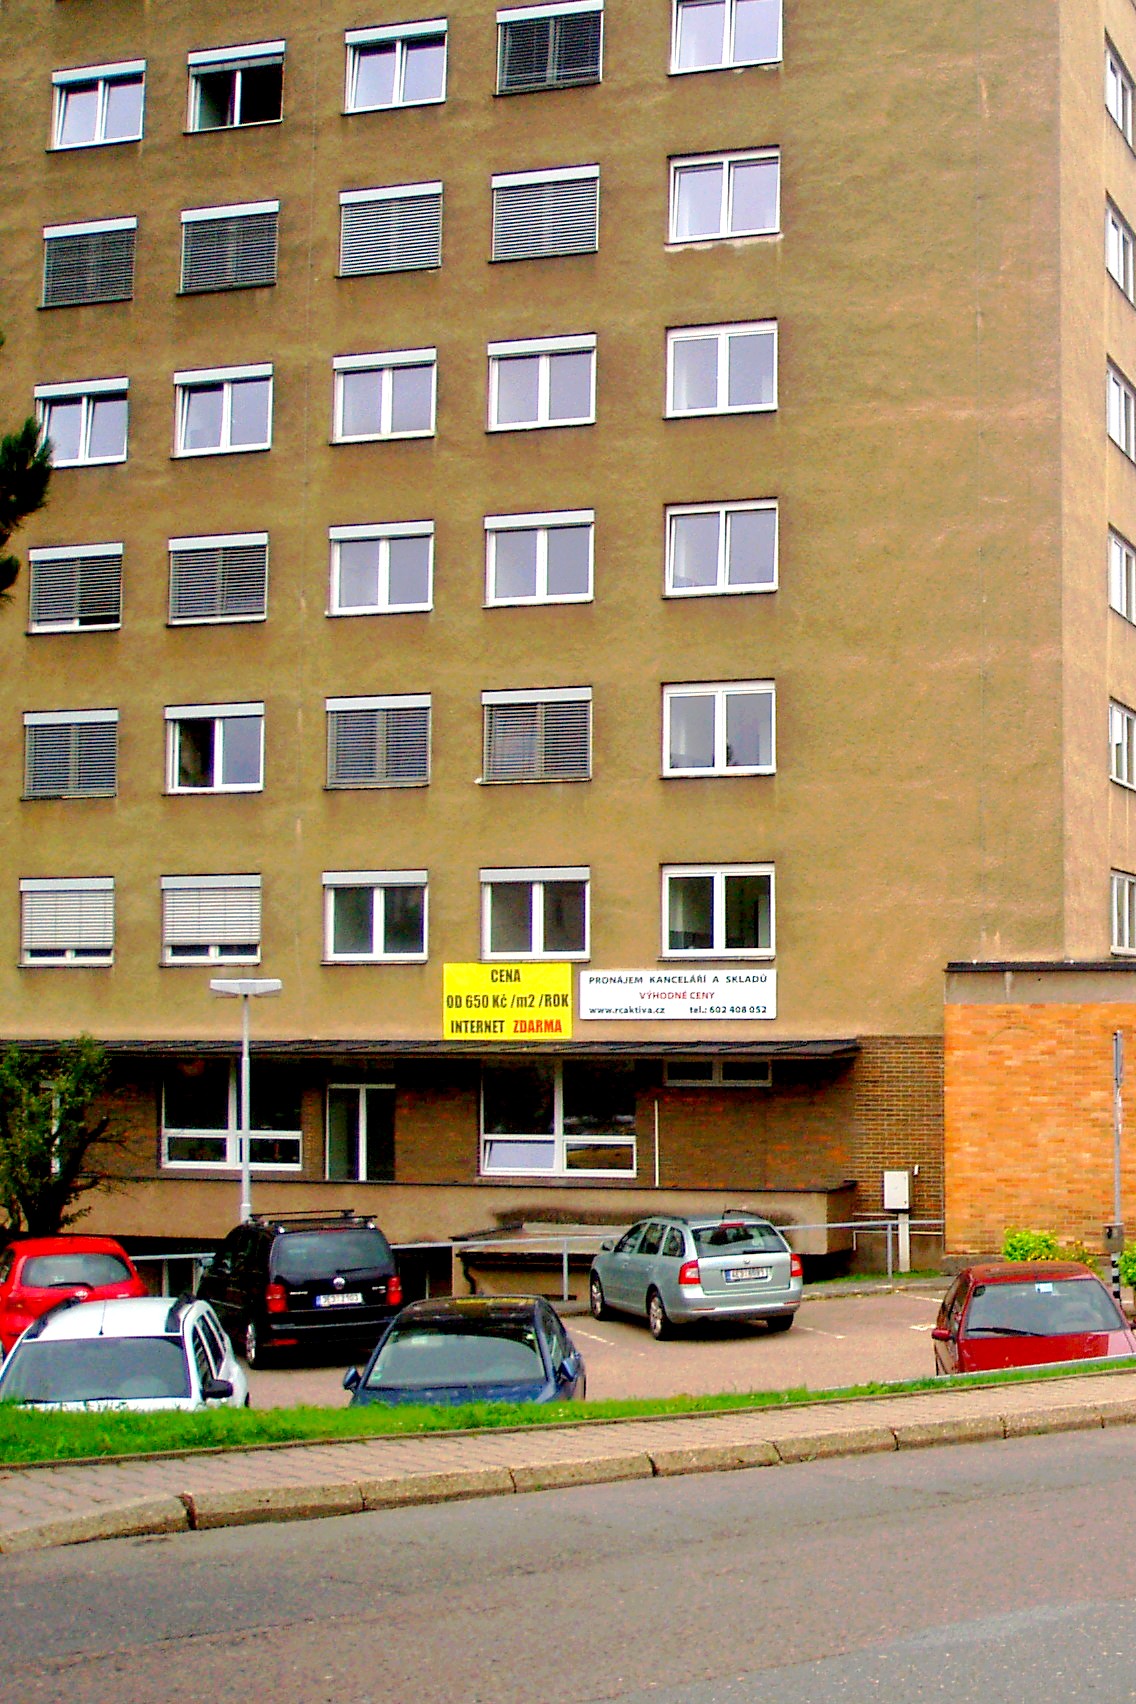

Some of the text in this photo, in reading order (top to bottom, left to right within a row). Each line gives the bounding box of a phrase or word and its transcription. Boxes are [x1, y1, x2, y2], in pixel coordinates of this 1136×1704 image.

[490, 969, 521, 983] CENA
[588, 973, 768, 984] PRONÁJEM KANCELÁŘÍ A SKLADŮ
[446, 994, 463, 1008] OD
[465, 994, 489, 1008] 650
[492, 993, 508, 1008] Kč
[639, 990, 715, 1000] VÝHODNÉ CENY
[588, 1005, 666, 1014] www.rcaktiva.cz
[709, 1005, 727, 1014] 602
[729, 1005, 747, 1014] 408
[749, 1005, 767, 1014] 052
[450, 1019, 563, 1034] INTERNET ZDARMA
